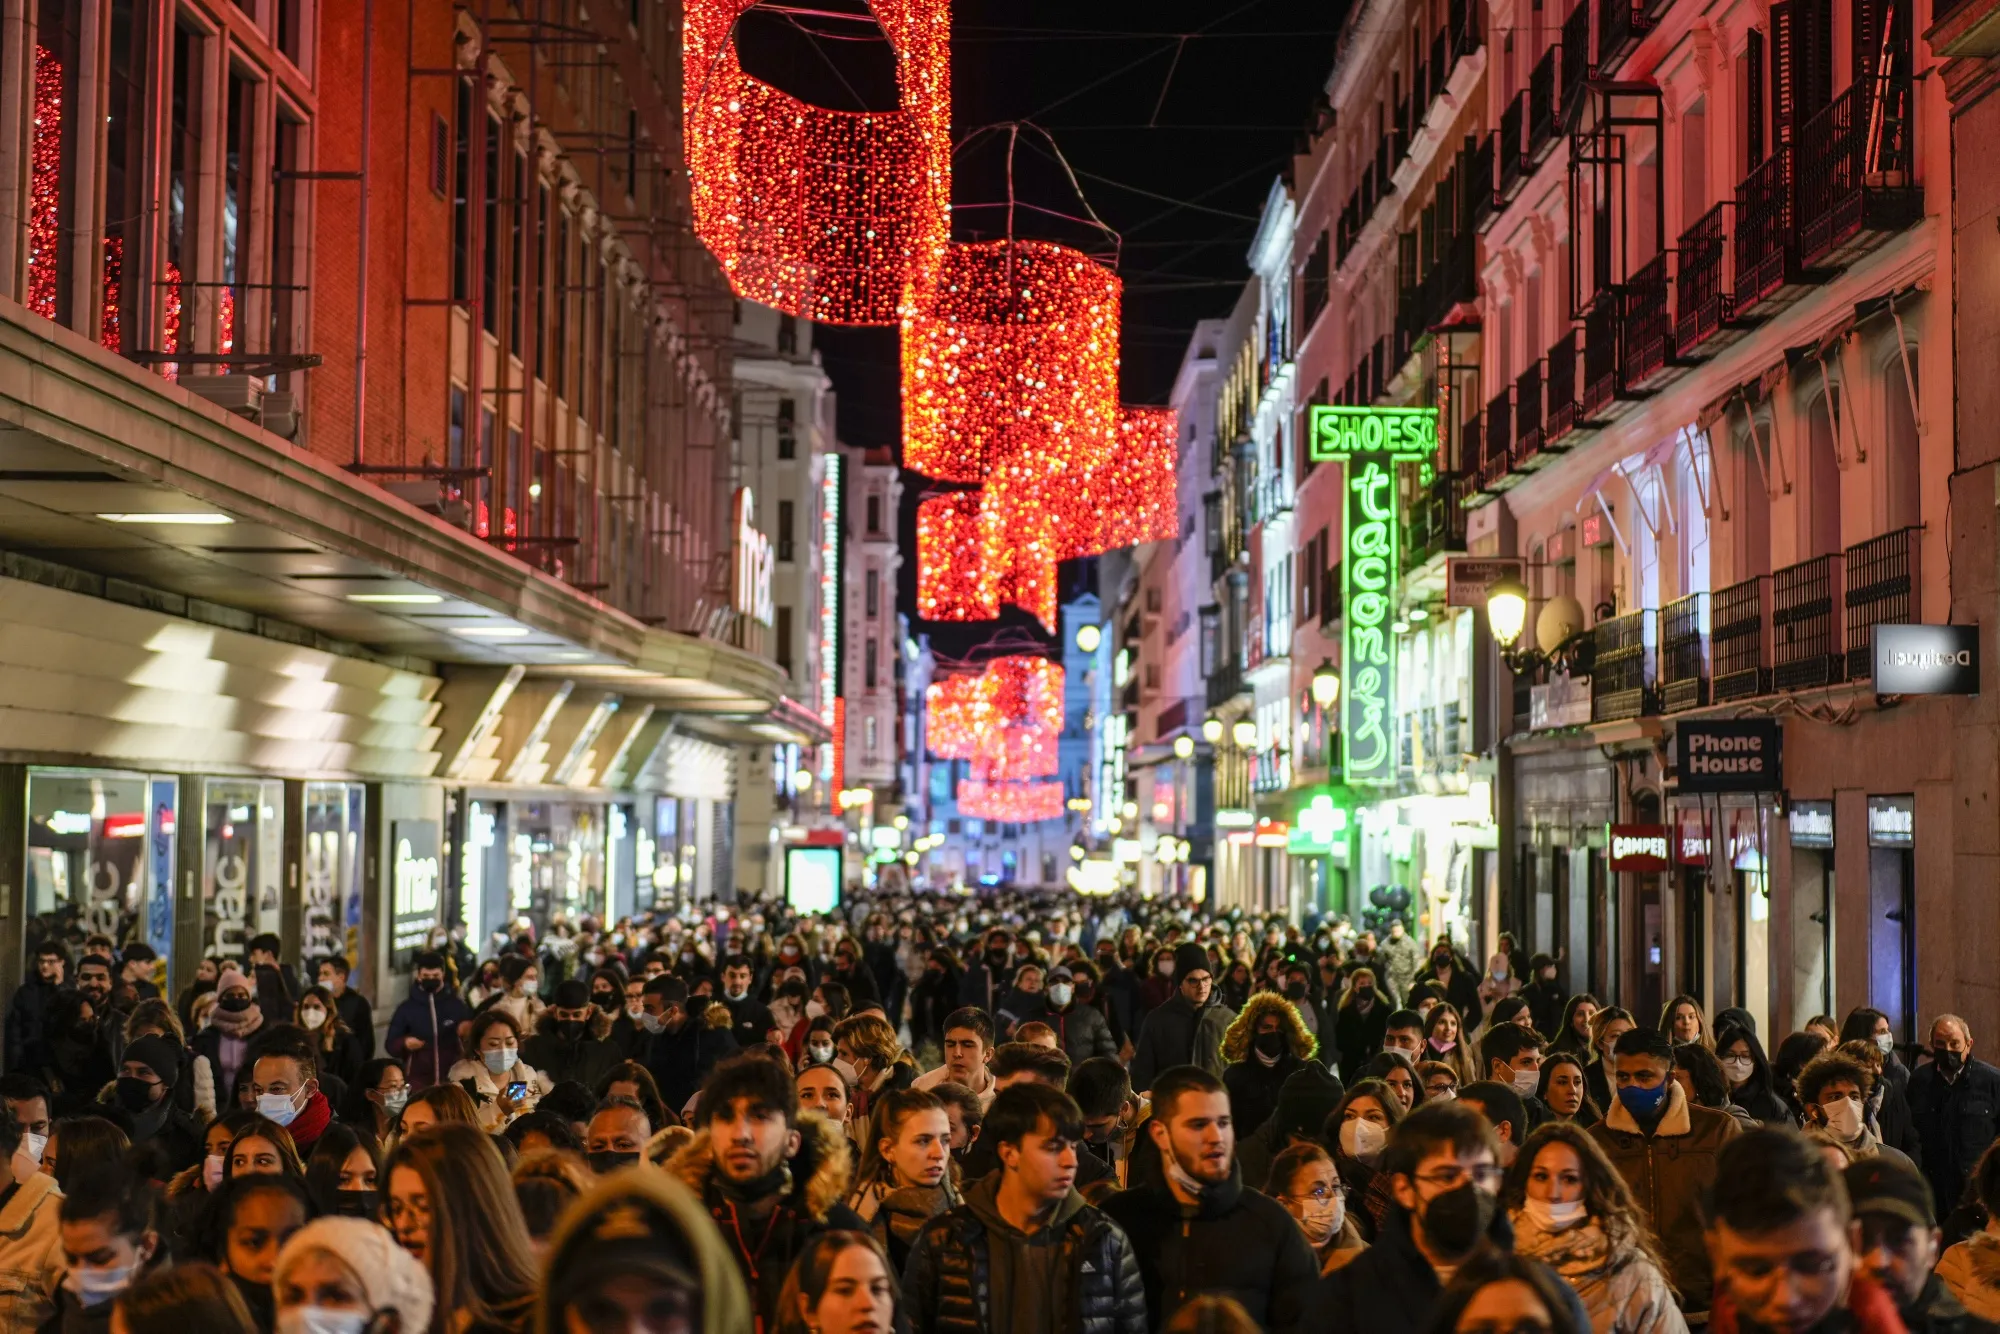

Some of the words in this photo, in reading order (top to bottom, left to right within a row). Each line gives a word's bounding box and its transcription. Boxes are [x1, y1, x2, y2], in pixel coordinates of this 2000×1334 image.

[1320, 414, 1422, 452] SHOES
[1350, 462, 1391, 771] tacones
[1689, 734, 1761, 753] Phone
[1690, 755, 1762, 774] House
[395, 838, 438, 915] fnac
[205, 855, 246, 957] nac
